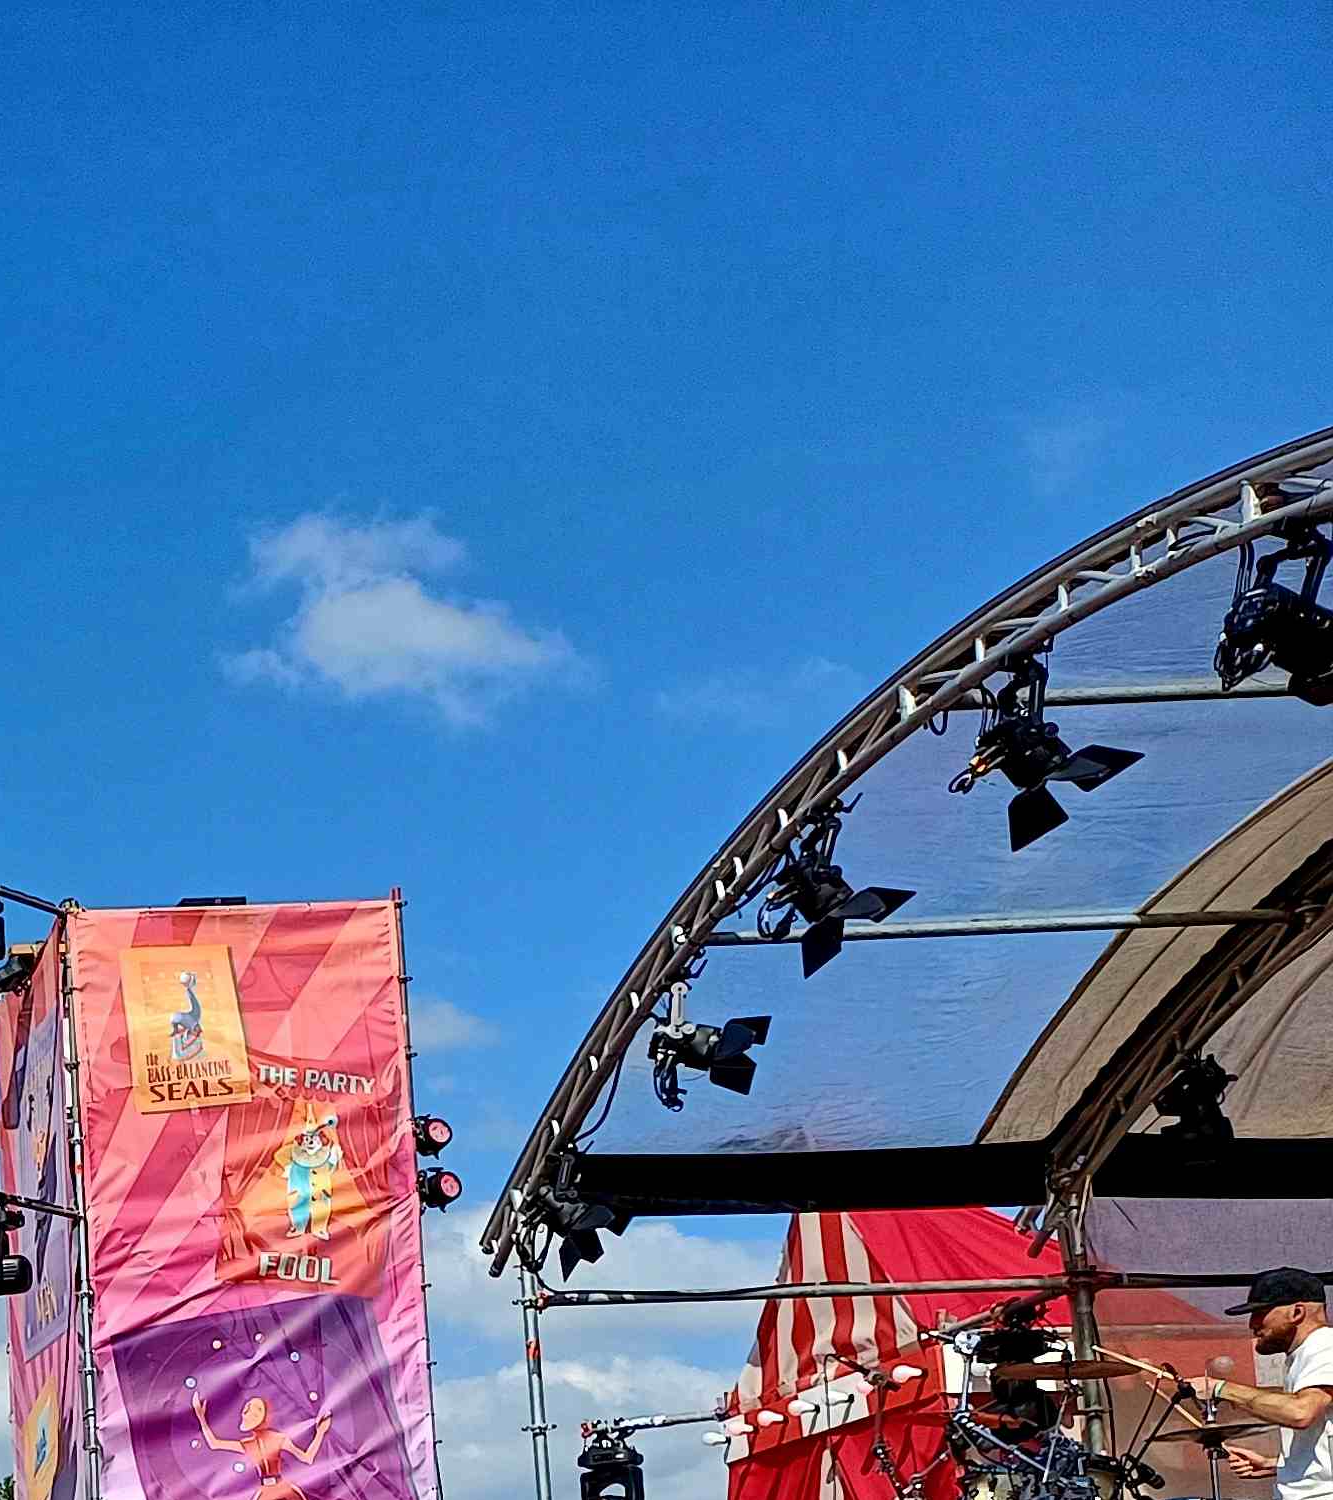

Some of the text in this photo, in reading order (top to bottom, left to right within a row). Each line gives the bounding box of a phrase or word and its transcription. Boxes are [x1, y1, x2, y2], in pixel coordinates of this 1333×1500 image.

[150, 1076, 233, 1103] SEALS
[257, 1063, 375, 1095] THE PARTY
[258, 1251, 341, 1285] FOOL
